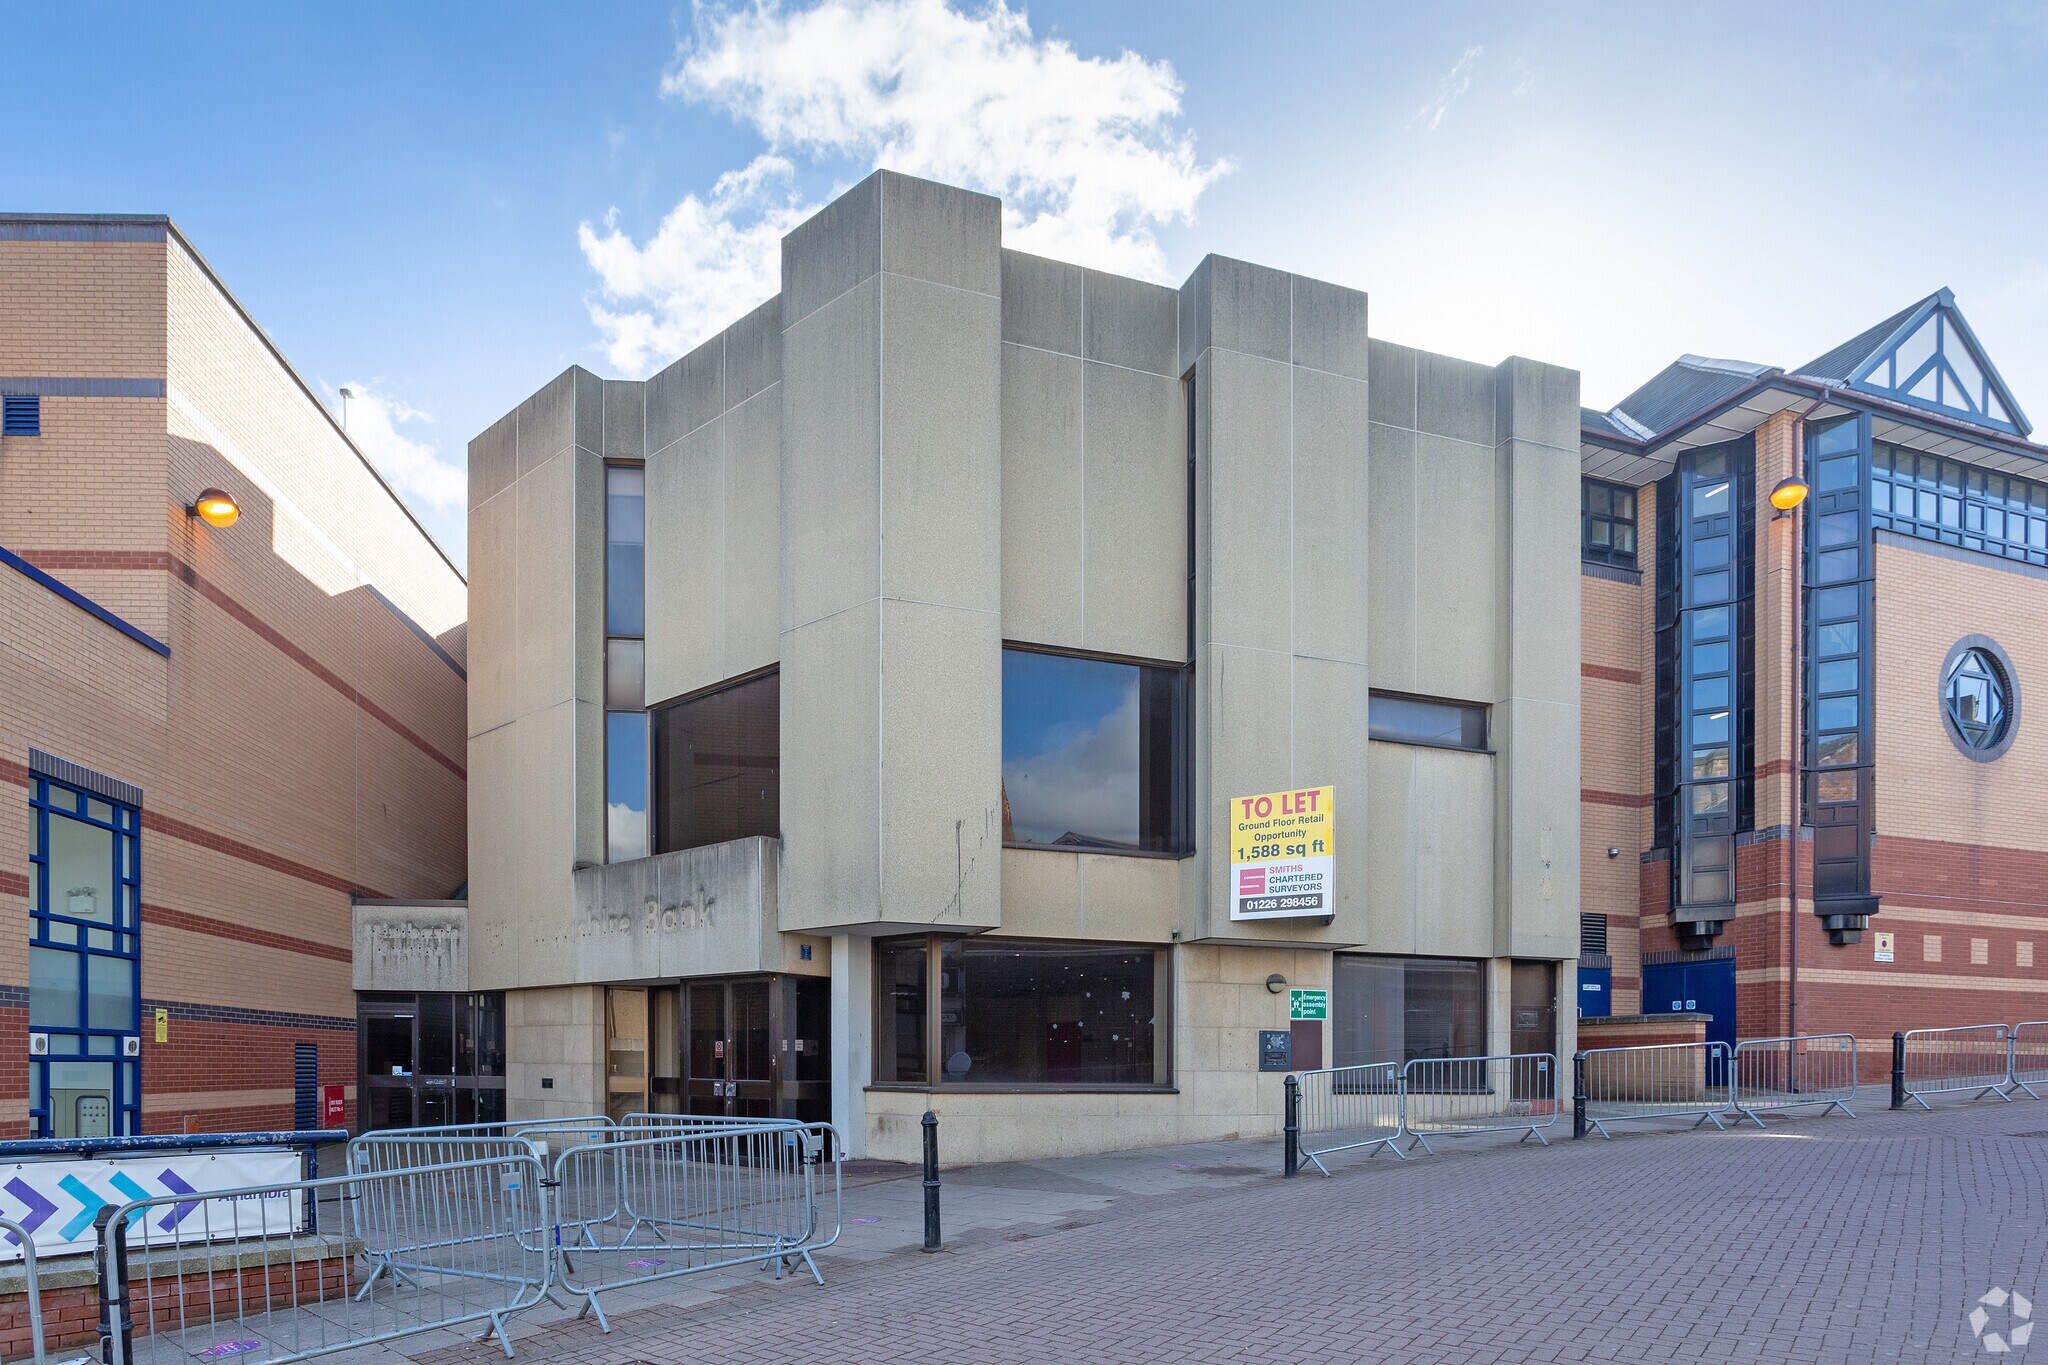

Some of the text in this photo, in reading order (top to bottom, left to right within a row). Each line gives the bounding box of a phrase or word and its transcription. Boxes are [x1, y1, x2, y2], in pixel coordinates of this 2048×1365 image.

[1242, 790, 1320, 819] TO LET
[1238, 814, 1324, 831] Ground Floor Retail
[1254, 829, 1306, 842] Opportunity
[1238, 839, 1324, 861] 1,588 sq ft
[1269, 864, 1303, 874] SMITHS
[1269, 873, 1323, 884] CHARTERED
[1269, 883, 1322, 894] SURVEYORS
[1247, 896, 1318, 909] 01226 298456
[645, 889, 715, 933] Bank
